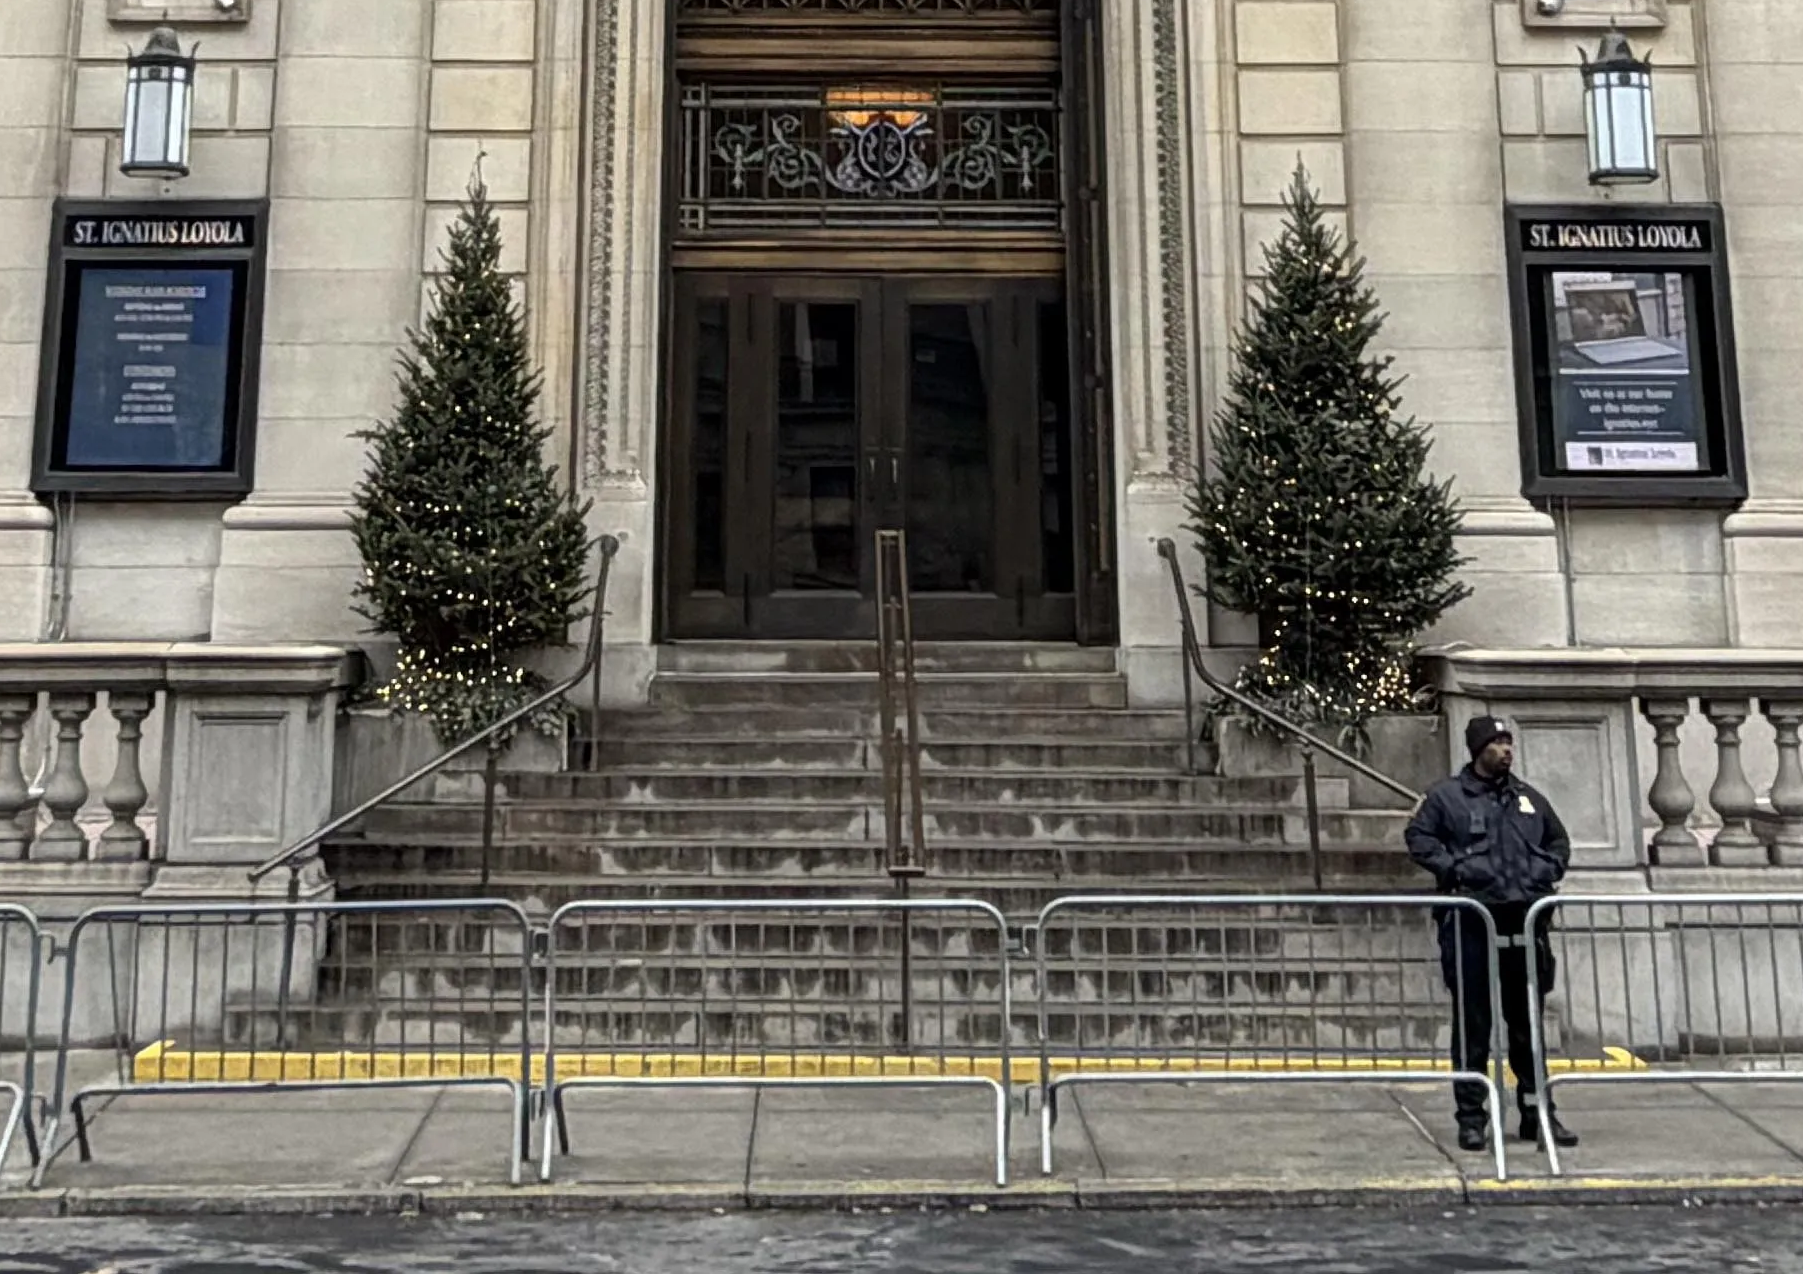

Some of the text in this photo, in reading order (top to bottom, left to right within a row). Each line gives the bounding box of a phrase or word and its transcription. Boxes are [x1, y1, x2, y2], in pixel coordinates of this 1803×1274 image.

[73, 220, 245, 244] ST. IGNATIUS LOYOLA
[1529, 223, 1703, 248] ST. IGNATIUS LOYOLA
